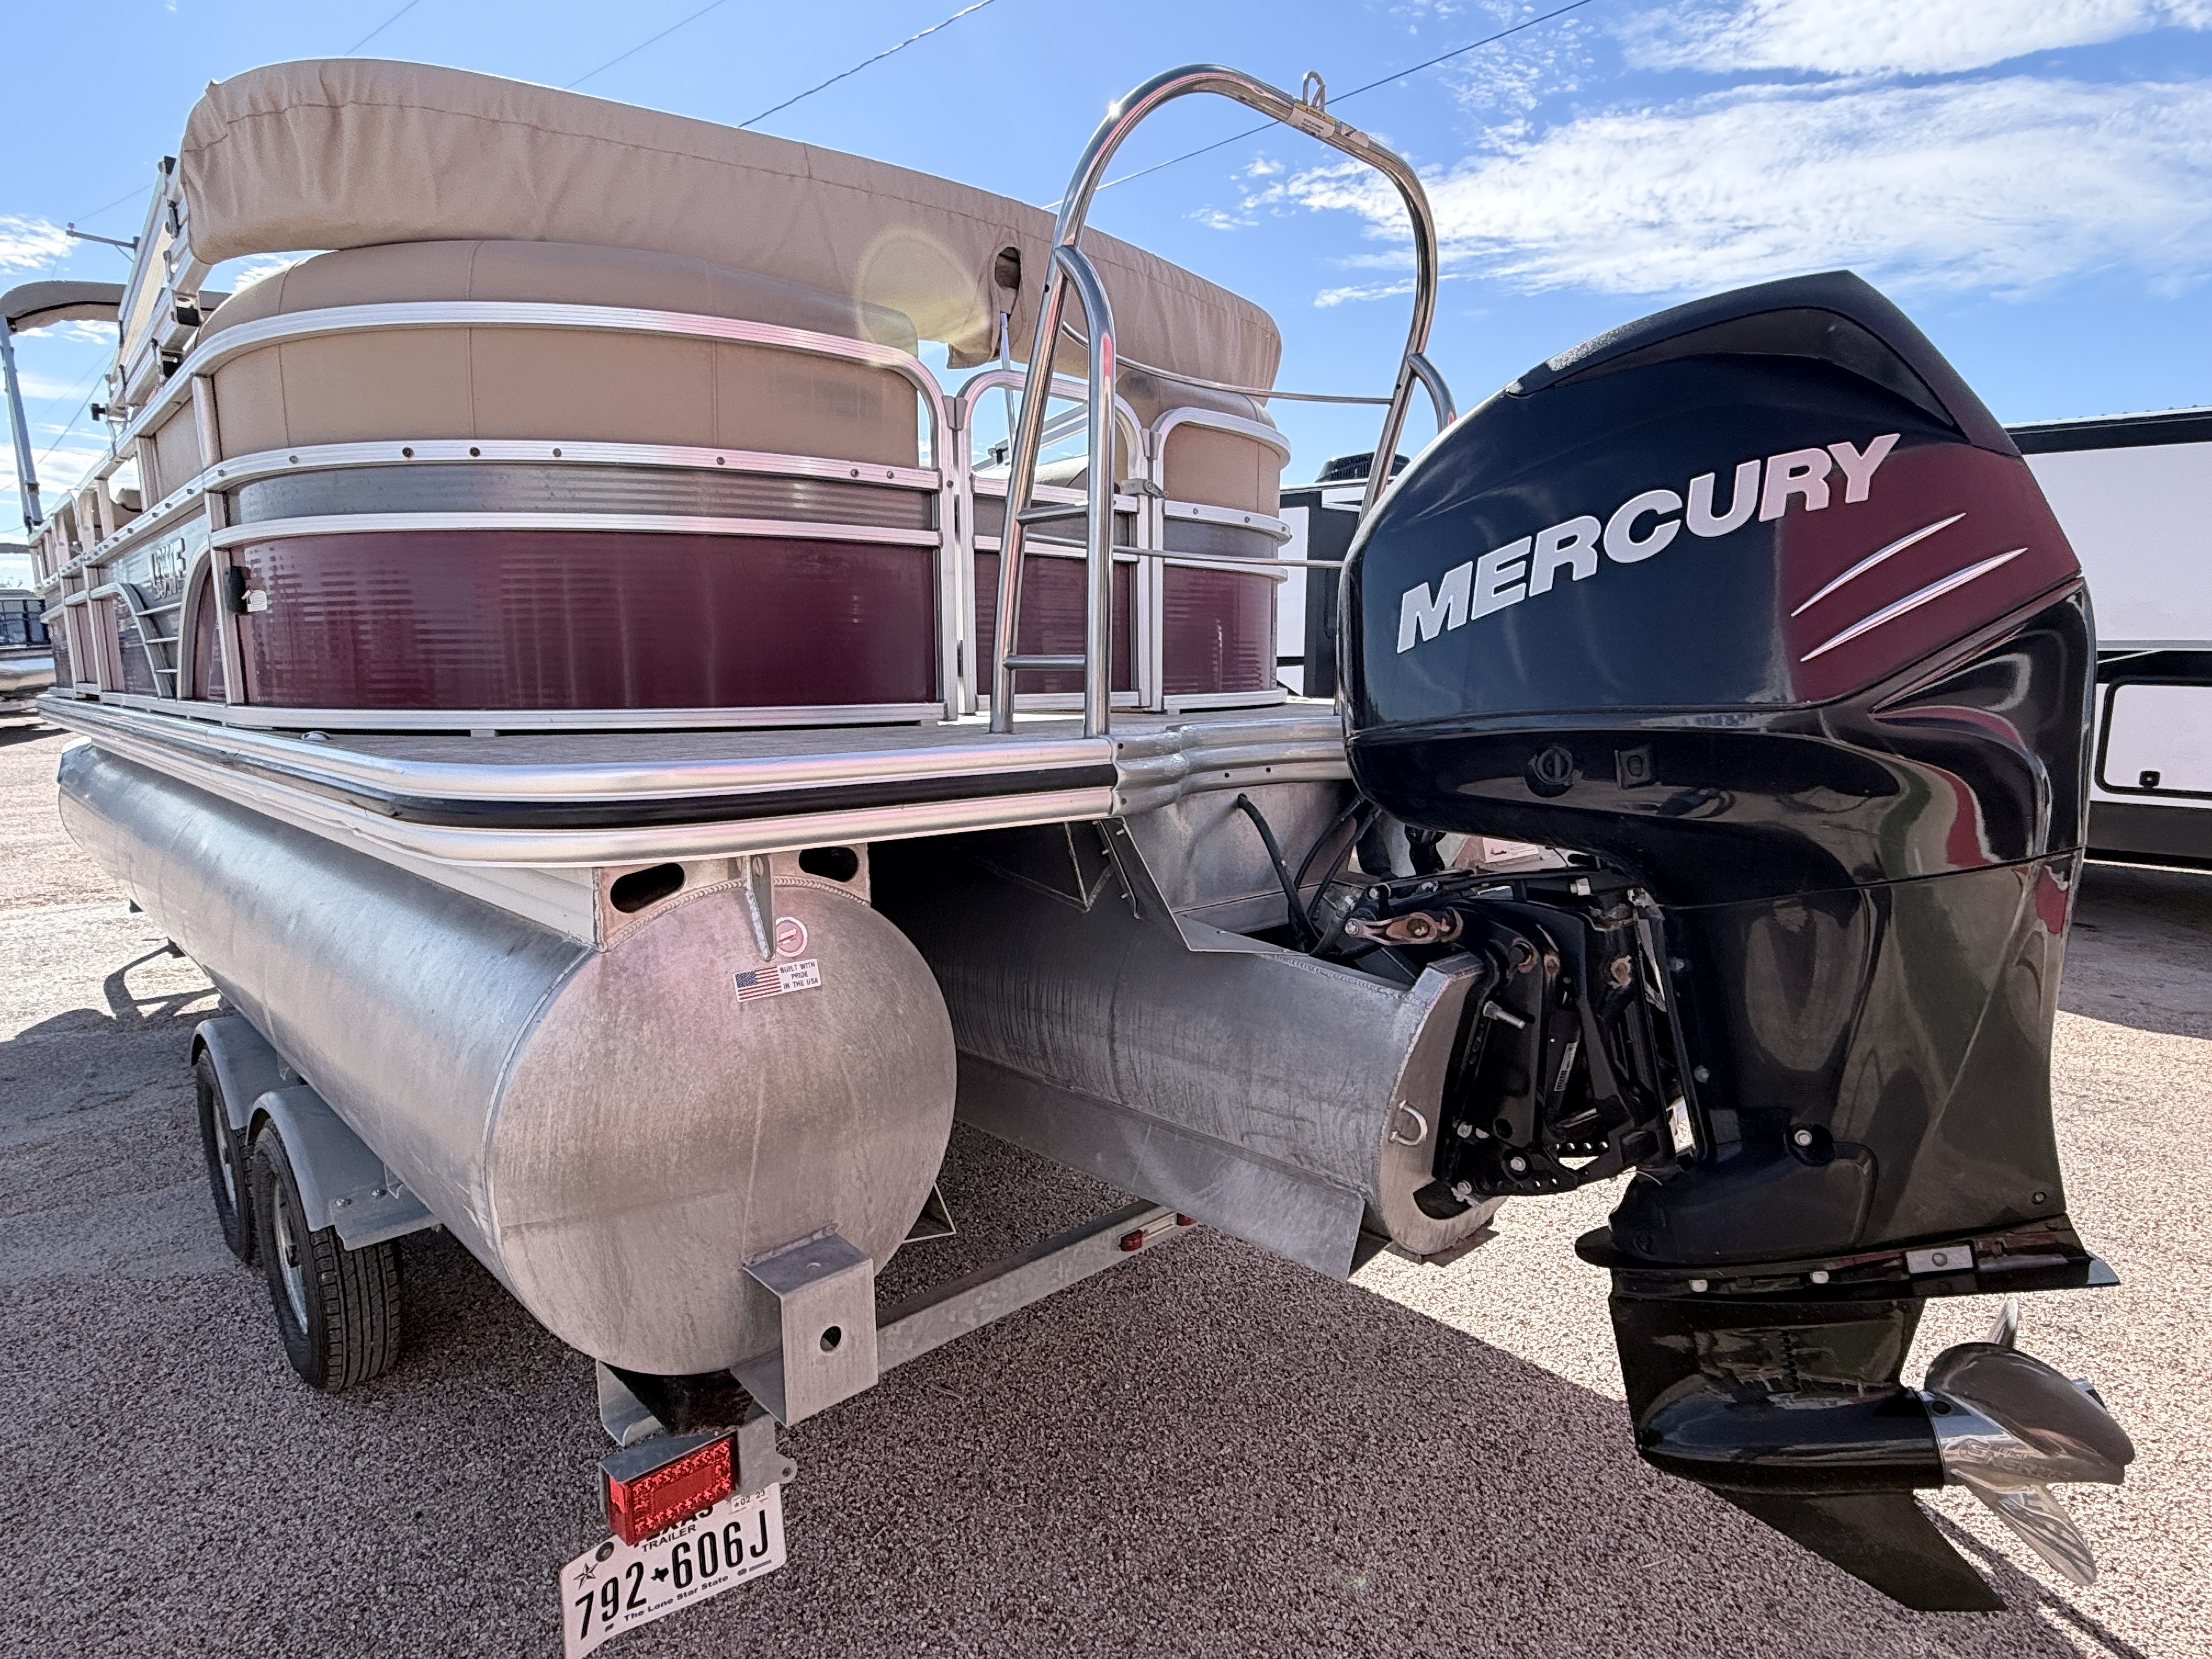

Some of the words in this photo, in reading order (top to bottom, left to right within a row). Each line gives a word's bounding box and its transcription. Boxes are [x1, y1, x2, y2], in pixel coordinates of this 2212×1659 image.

[1397, 433, 1901, 654] MERCURY
[780, 964, 798, 974] BUILT
[799, 961, 816, 970] WITH
[791, 970, 809, 980] PRIDE
[792, 980, 805, 988] THE
[642, 1524, 697, 1553] TRAILER
[574, 1561, 647, 1640] 792
[671, 1509, 769, 1589] 606J
[624, 1610, 645, 1622] The
[647, 1597, 674, 1613] Lone
[676, 1588, 699, 1601] Star
[701, 1575, 729, 1591] State
